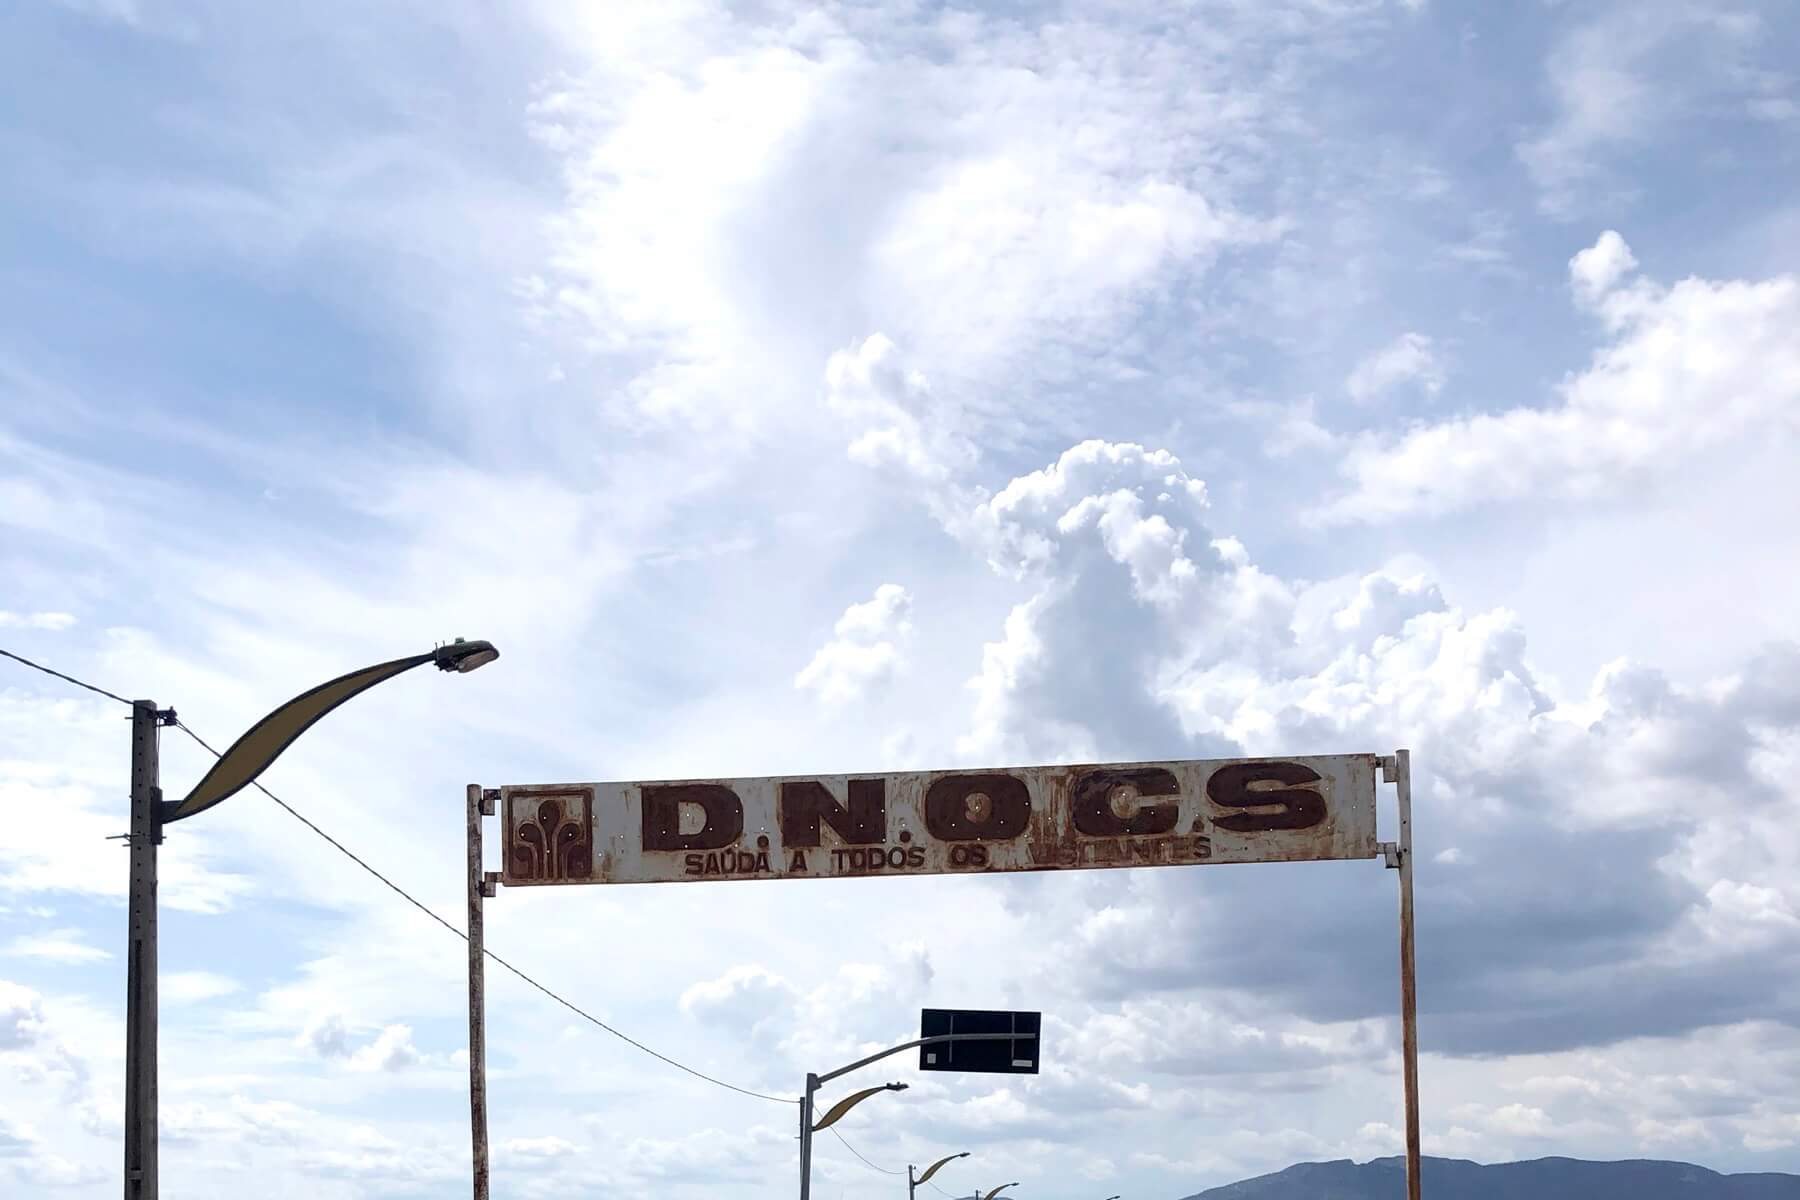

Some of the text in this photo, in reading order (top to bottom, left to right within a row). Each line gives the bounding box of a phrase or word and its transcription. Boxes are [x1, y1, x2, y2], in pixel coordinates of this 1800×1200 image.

[788, 849, 808, 872] A
[831, 846, 926, 870] TODOS
[951, 844, 987, 868] OS
